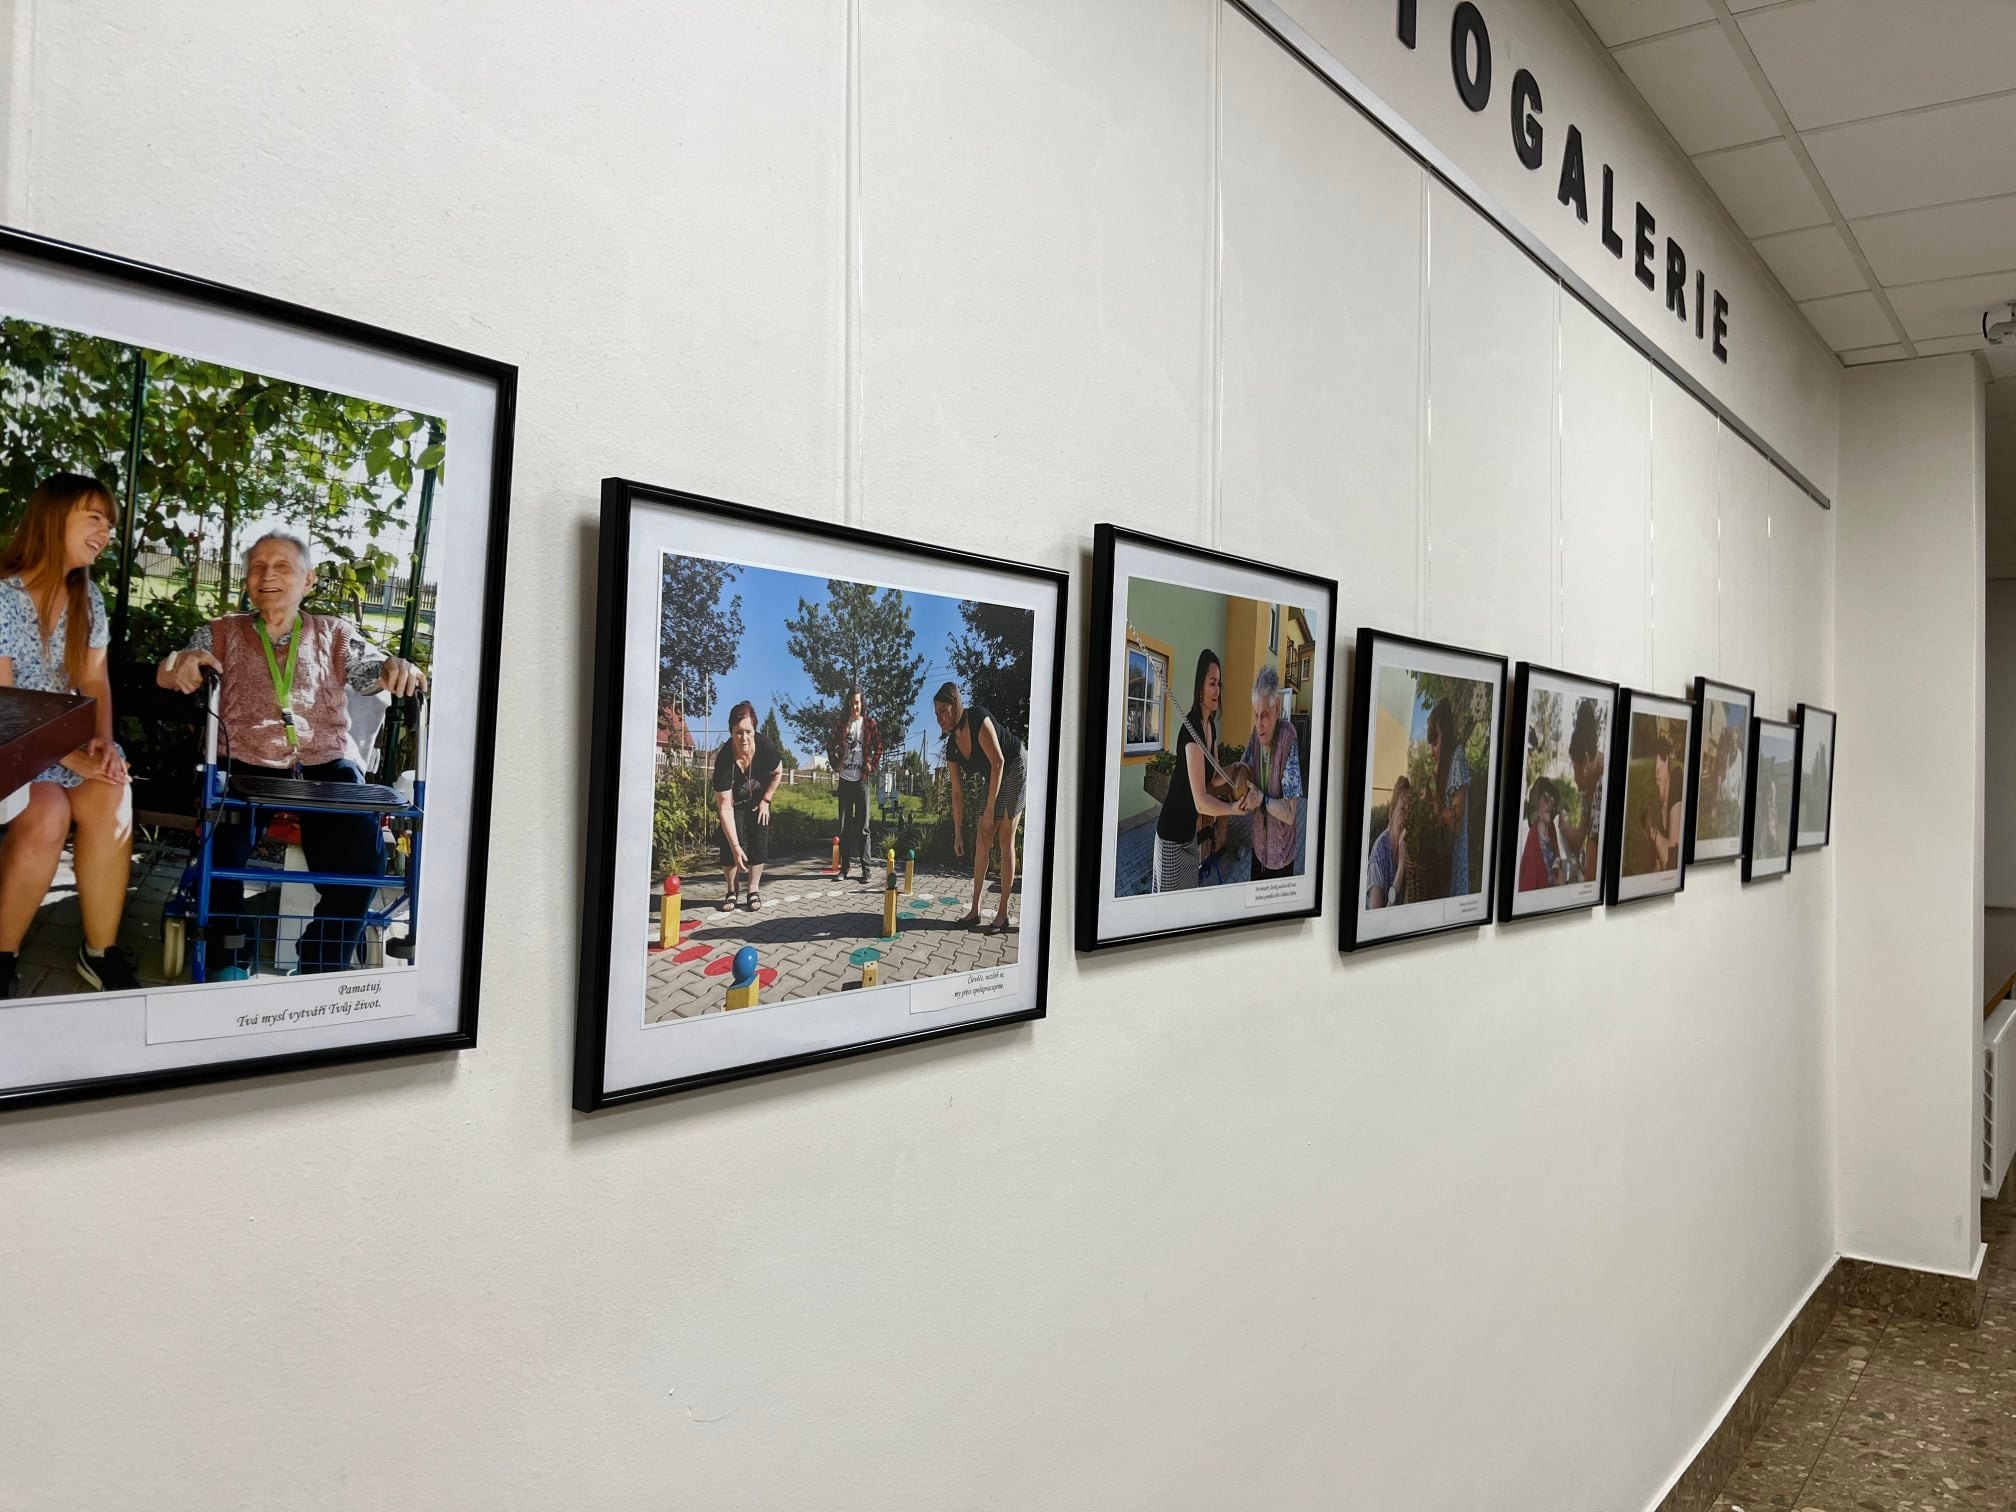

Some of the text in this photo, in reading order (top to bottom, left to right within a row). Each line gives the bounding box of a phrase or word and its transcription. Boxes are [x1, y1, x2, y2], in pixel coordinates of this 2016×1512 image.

[338, 980, 382, 995] Pamatuj,
[236, 999, 382, 1028] Tvá mysl vytváří Tvůj život.
